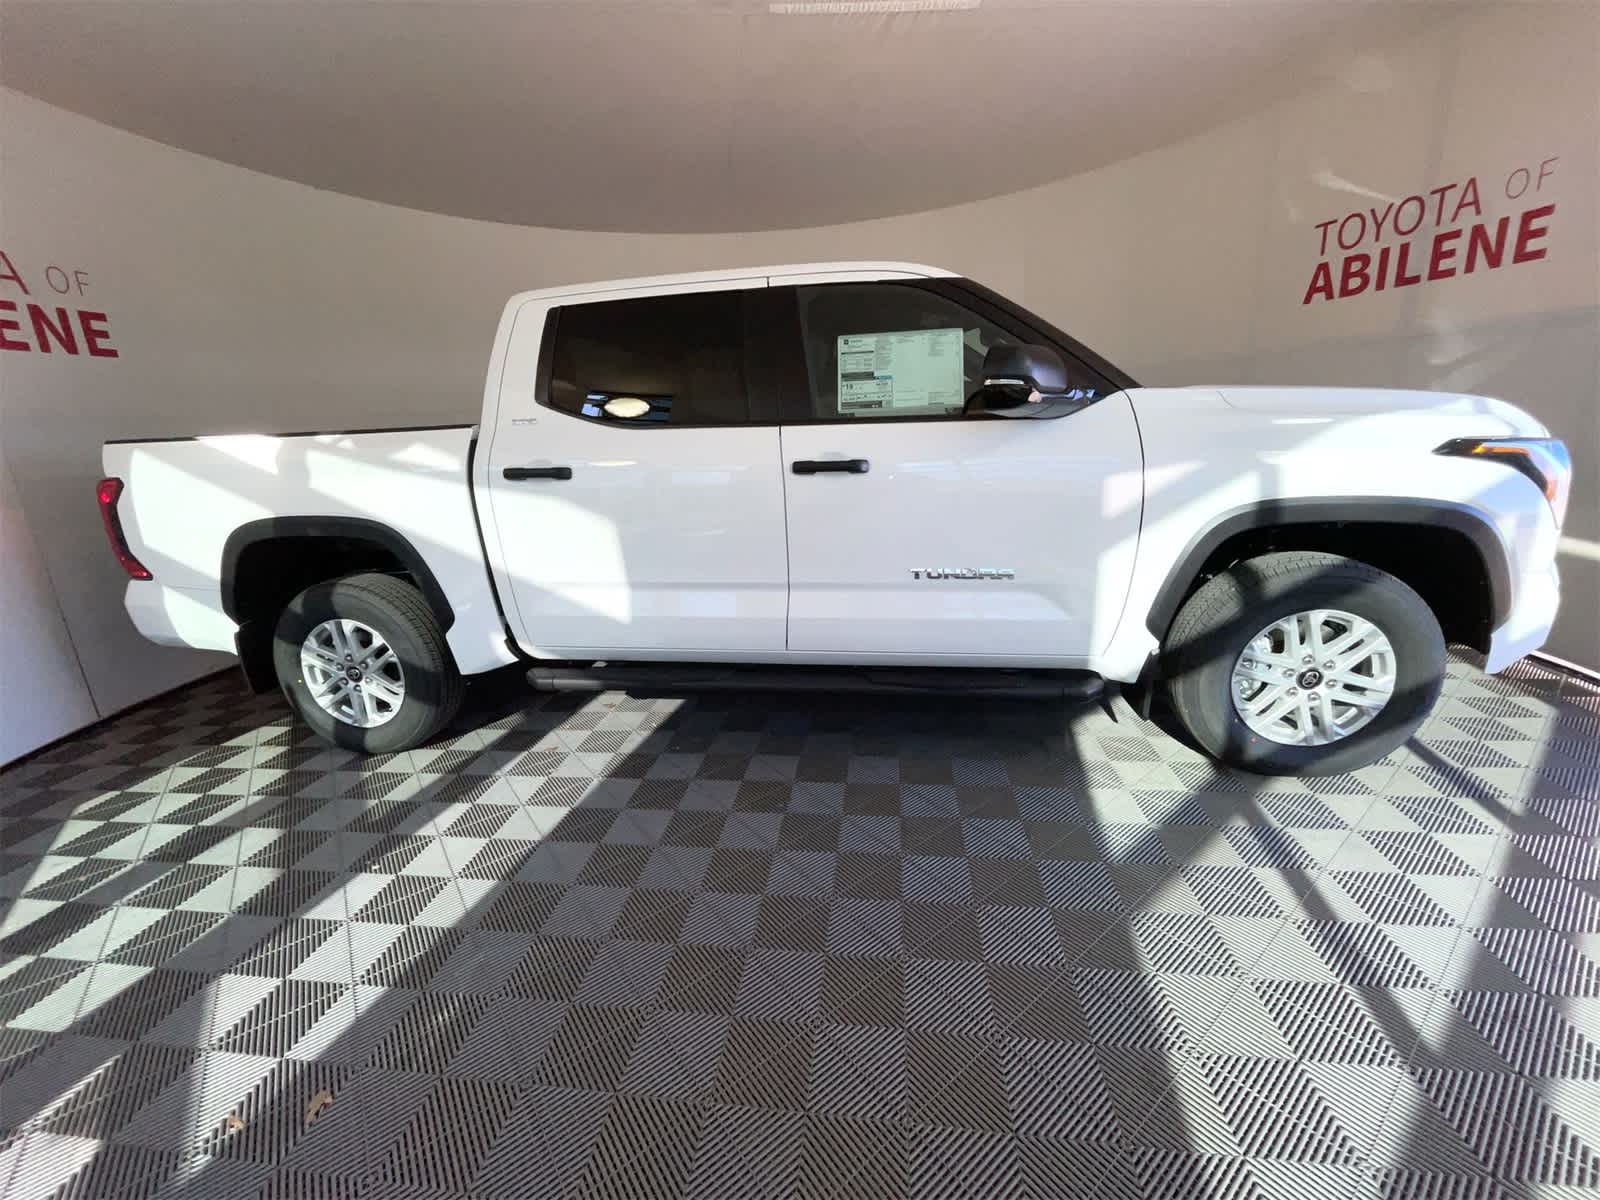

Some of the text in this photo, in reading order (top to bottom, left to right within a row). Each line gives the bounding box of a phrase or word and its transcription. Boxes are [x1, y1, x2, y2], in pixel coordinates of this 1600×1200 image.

[1302, 203, 1556, 305] ABILENE
[1314, 156, 1559, 257] TOYOTA OF
[45, 265, 89, 297] OF
